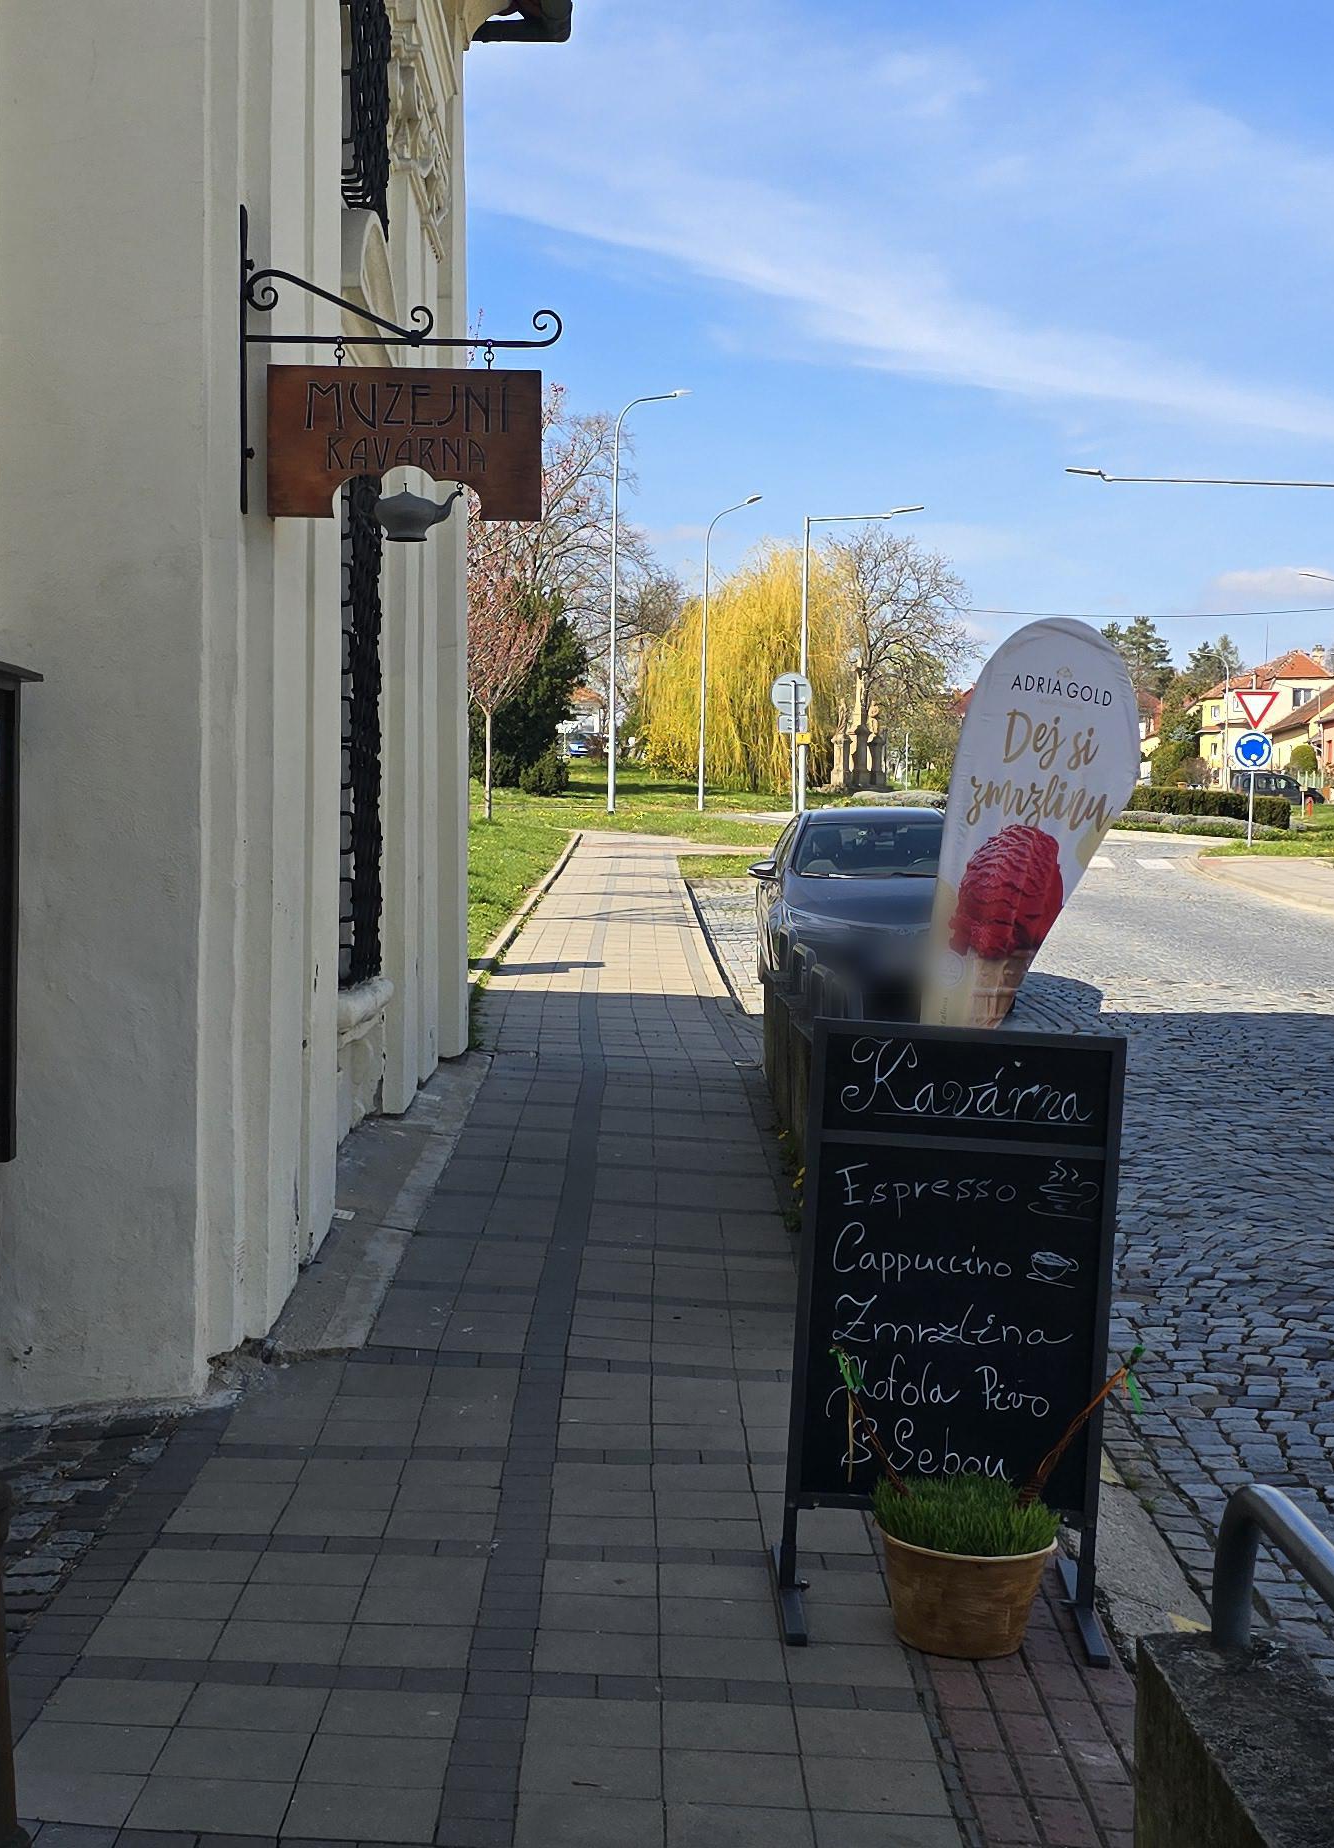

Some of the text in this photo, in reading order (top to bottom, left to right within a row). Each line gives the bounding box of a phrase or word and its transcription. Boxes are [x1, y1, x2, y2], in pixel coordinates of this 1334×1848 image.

[304, 379, 509, 434] MUZEJNÍ
[326, 428, 487, 473] KAVÁRNA
[1002, 708, 1100, 772] Dej si
[966, 775, 1114, 832] zmrzlinu
[840, 1036, 1093, 1121] Kavárna
[835, 1163, 1017, 1219] Espresso
[832, 1221, 1012, 1283] Cappuccino
[832, 1293, 1074, 1345] Zmrzlina
[974, 1365, 1050, 1417] Pivo
